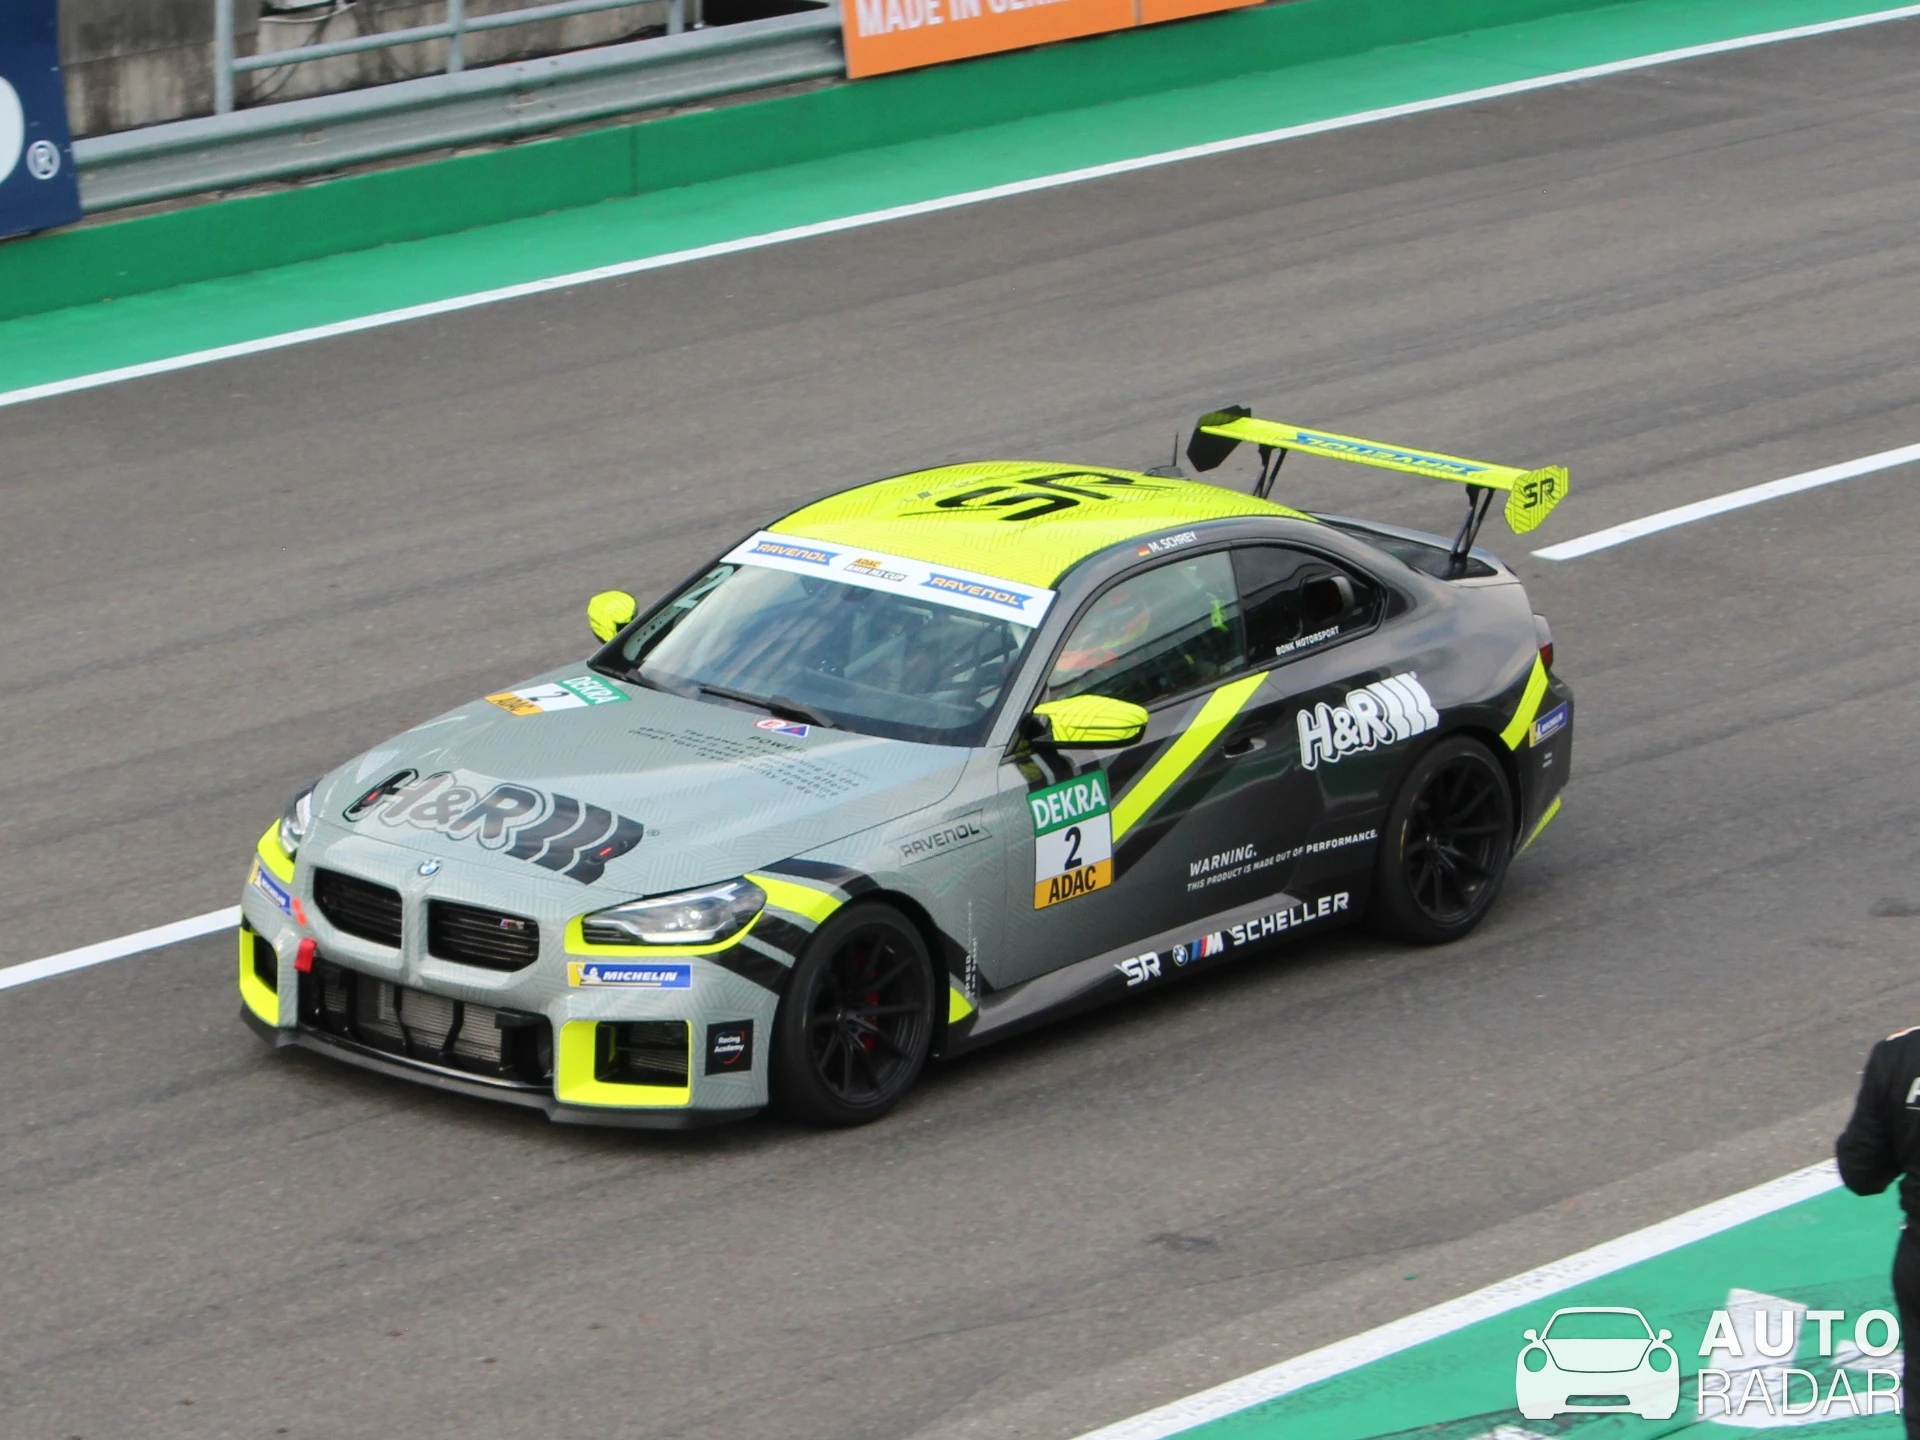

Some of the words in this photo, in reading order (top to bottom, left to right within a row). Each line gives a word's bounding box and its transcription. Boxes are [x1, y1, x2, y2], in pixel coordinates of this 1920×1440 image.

[857, 0, 943, 37] MADE
[1524, 478, 1554, 509] SR
[757, 544, 827, 563] RAVENOL
[1160, 531, 1198, 549] SCHREY
[854, 558, 881, 568] ADAC
[885, 572, 905, 581] CUP
[930, 577, 1019, 606] RAVENOL
[1276, 641, 1295, 655] BONK
[1295, 625, 1339, 648] MOTORSPORT
[562, 676, 620, 705] DEKRA
[1297, 689, 1396, 770] H&R
[344, 768, 546, 850] H&R
[1031, 778, 1106, 829] DEKRA
[901, 823, 980, 858] RAVENOL
[1064, 826, 1082, 870] 2
[1187, 878, 1204, 892] THIS
[1206, 868, 1242, 885] PRODUCT
[1243, 863, 1252, 874] IS
[1253, 856, 1275, 871] MADE
[1275, 850, 1291, 862] OUT
[1292, 847, 1304, 857] OF
[1306, 829, 1378, 854] PERFORMANCE.
[1189, 843, 1258, 877] WARNING.
[1048, 866, 1096, 904] ADAC
[1114, 951, 1162, 987] SR
[1228, 891, 1350, 947] SCHELLER
[602, 971, 678, 982] MICHELIN
